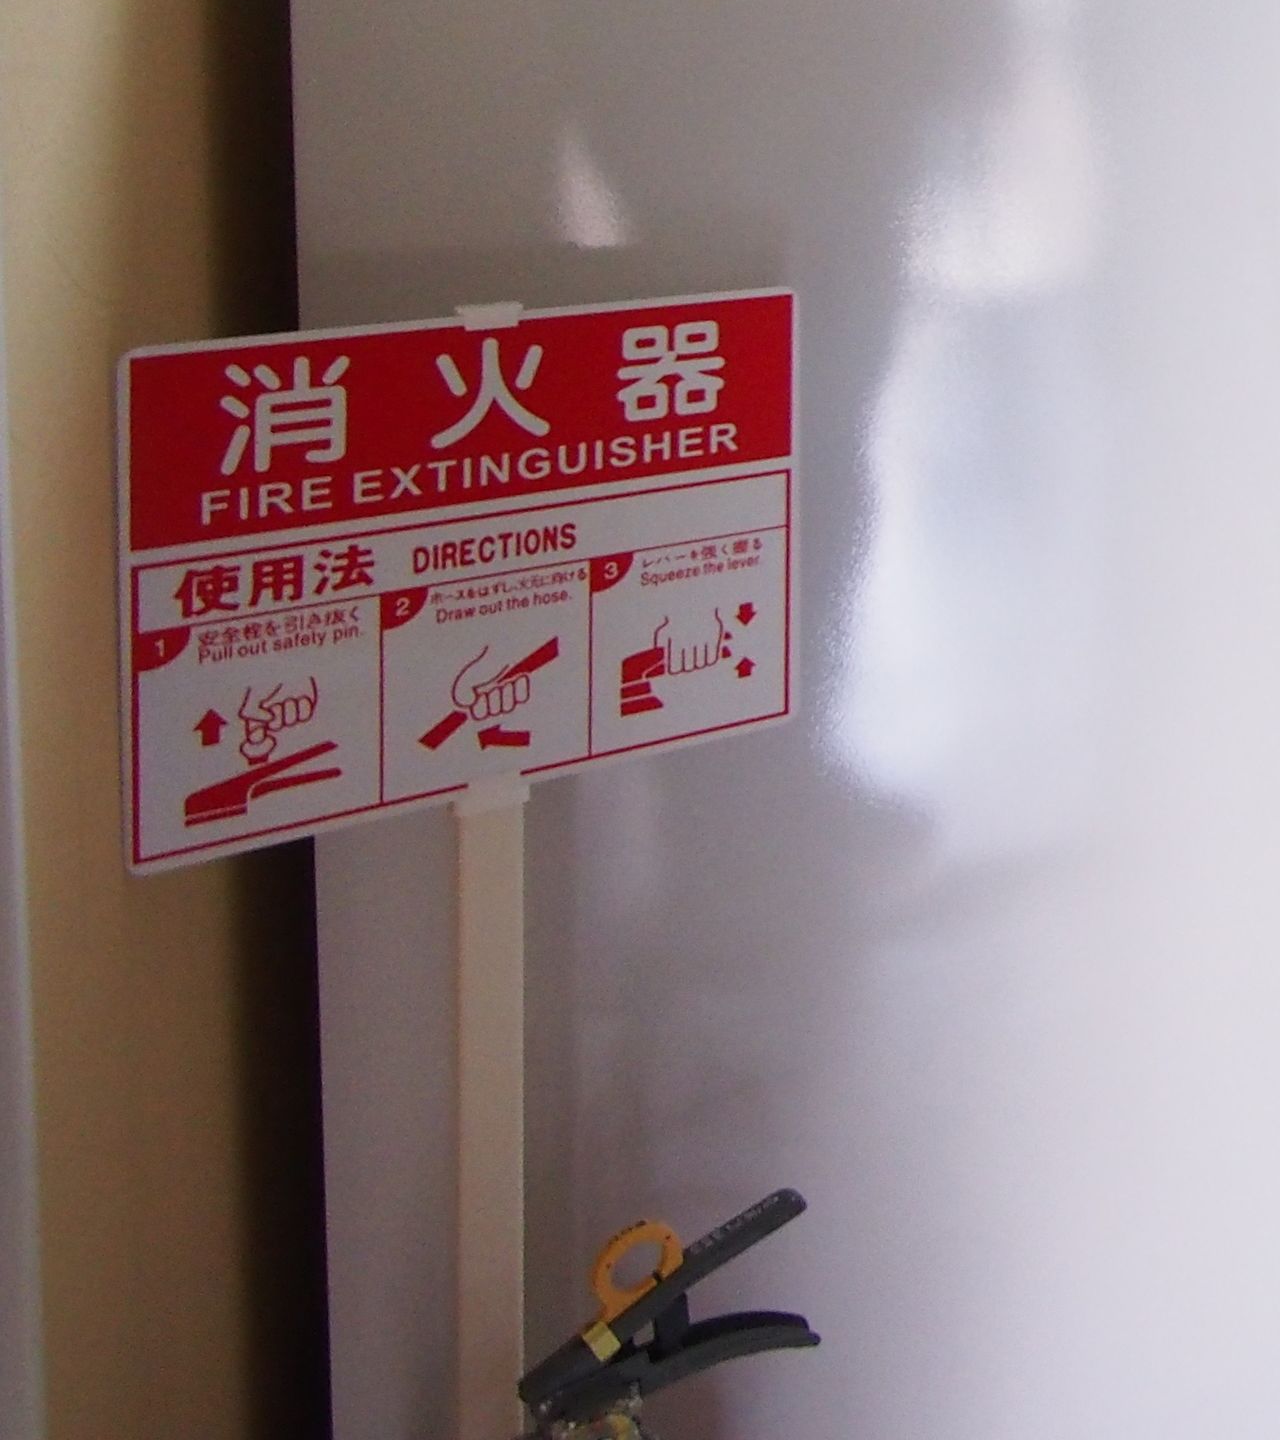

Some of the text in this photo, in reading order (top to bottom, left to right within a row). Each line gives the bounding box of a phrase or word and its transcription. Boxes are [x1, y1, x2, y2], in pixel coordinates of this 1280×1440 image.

[200, 422, 739, 526] FIRE EXTINGUISHER
[174, 523, 577, 618] 使用法 DIRECTIONS
[604, 561, 619, 580] 3
[640, 565, 700, 587] Squeeze
[703, 560, 725, 575] the
[395, 597, 411, 618] 2
[435, 588, 573, 625] Draw out the hose.
[154, 638, 166, 658] 1
[197, 640, 234, 665] Pull
[237, 637, 268, 658] out
[272, 629, 327, 652] safety
